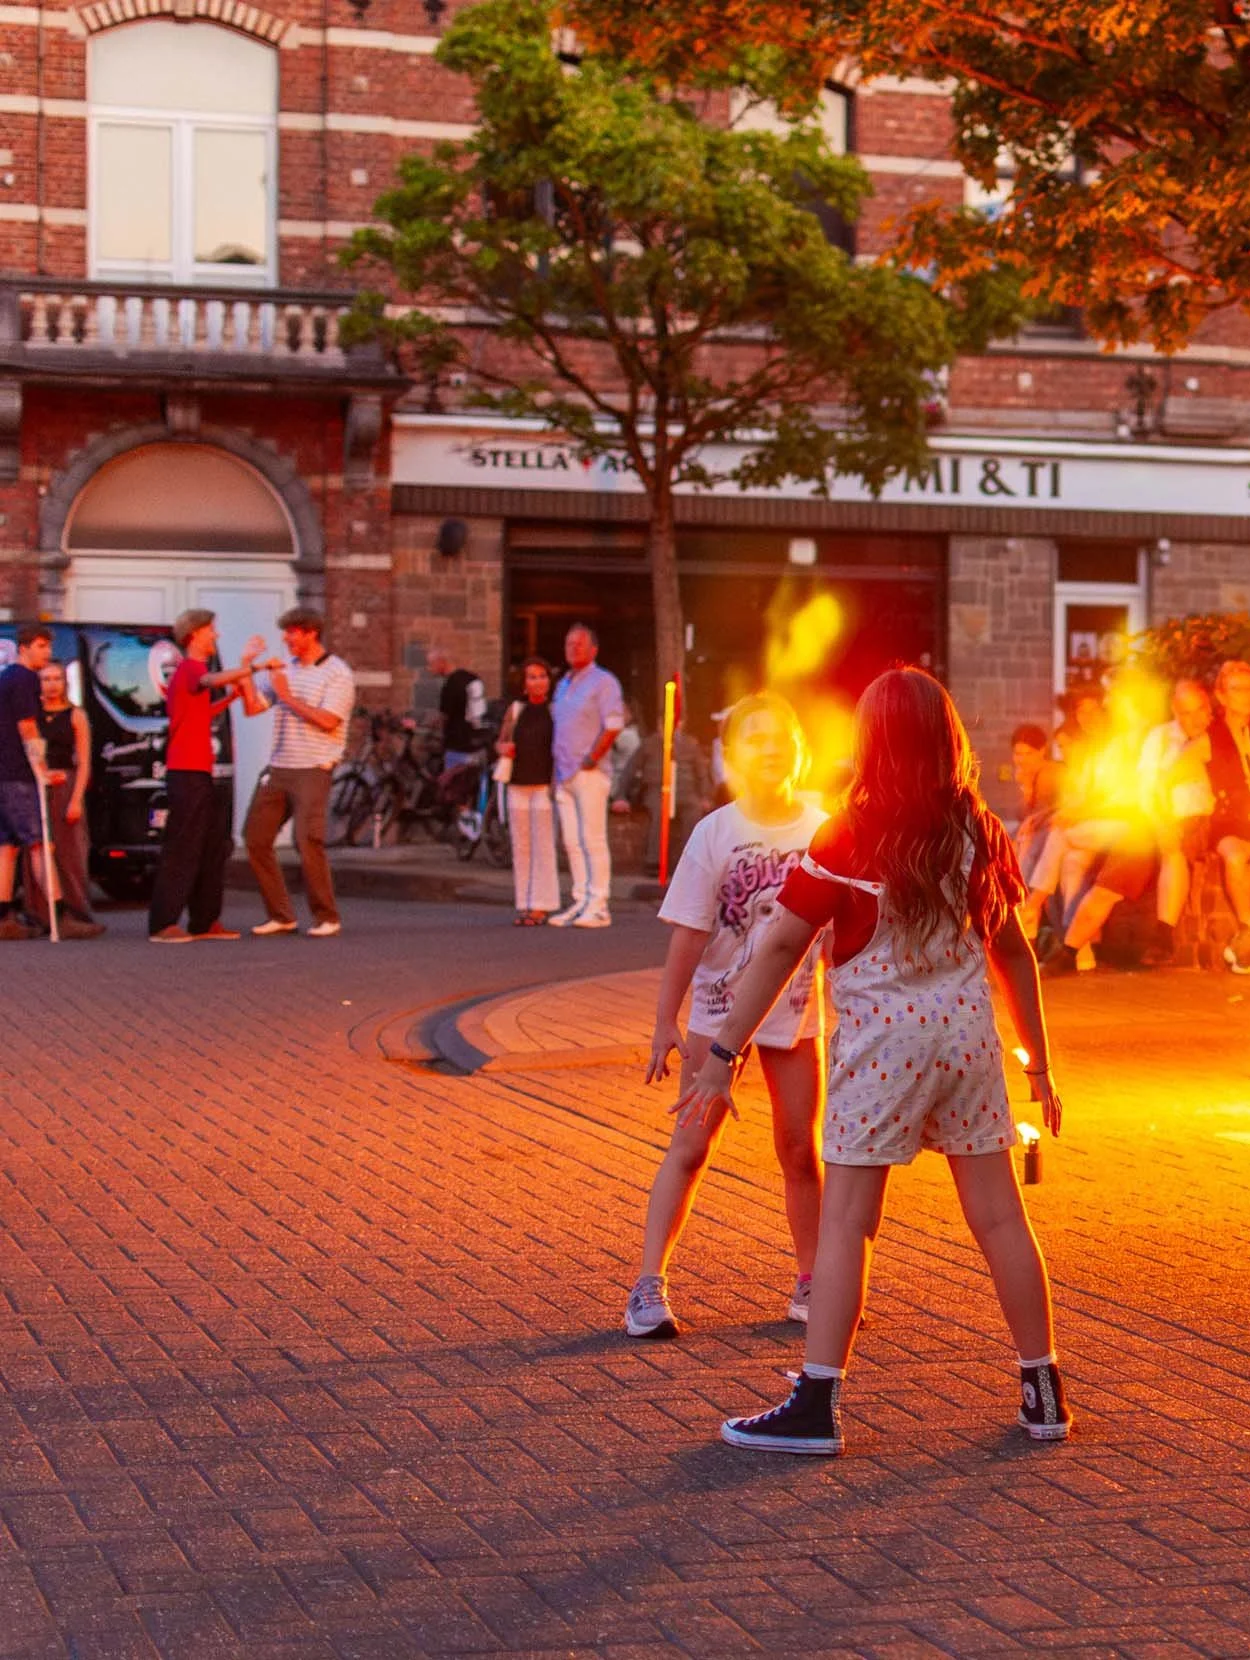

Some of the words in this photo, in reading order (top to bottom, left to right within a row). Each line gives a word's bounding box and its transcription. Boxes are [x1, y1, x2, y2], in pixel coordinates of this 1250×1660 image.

[471, 449, 569, 471] STELLA
[979, 458, 1017, 497] &
[1020, 461, 1061, 498] TI
